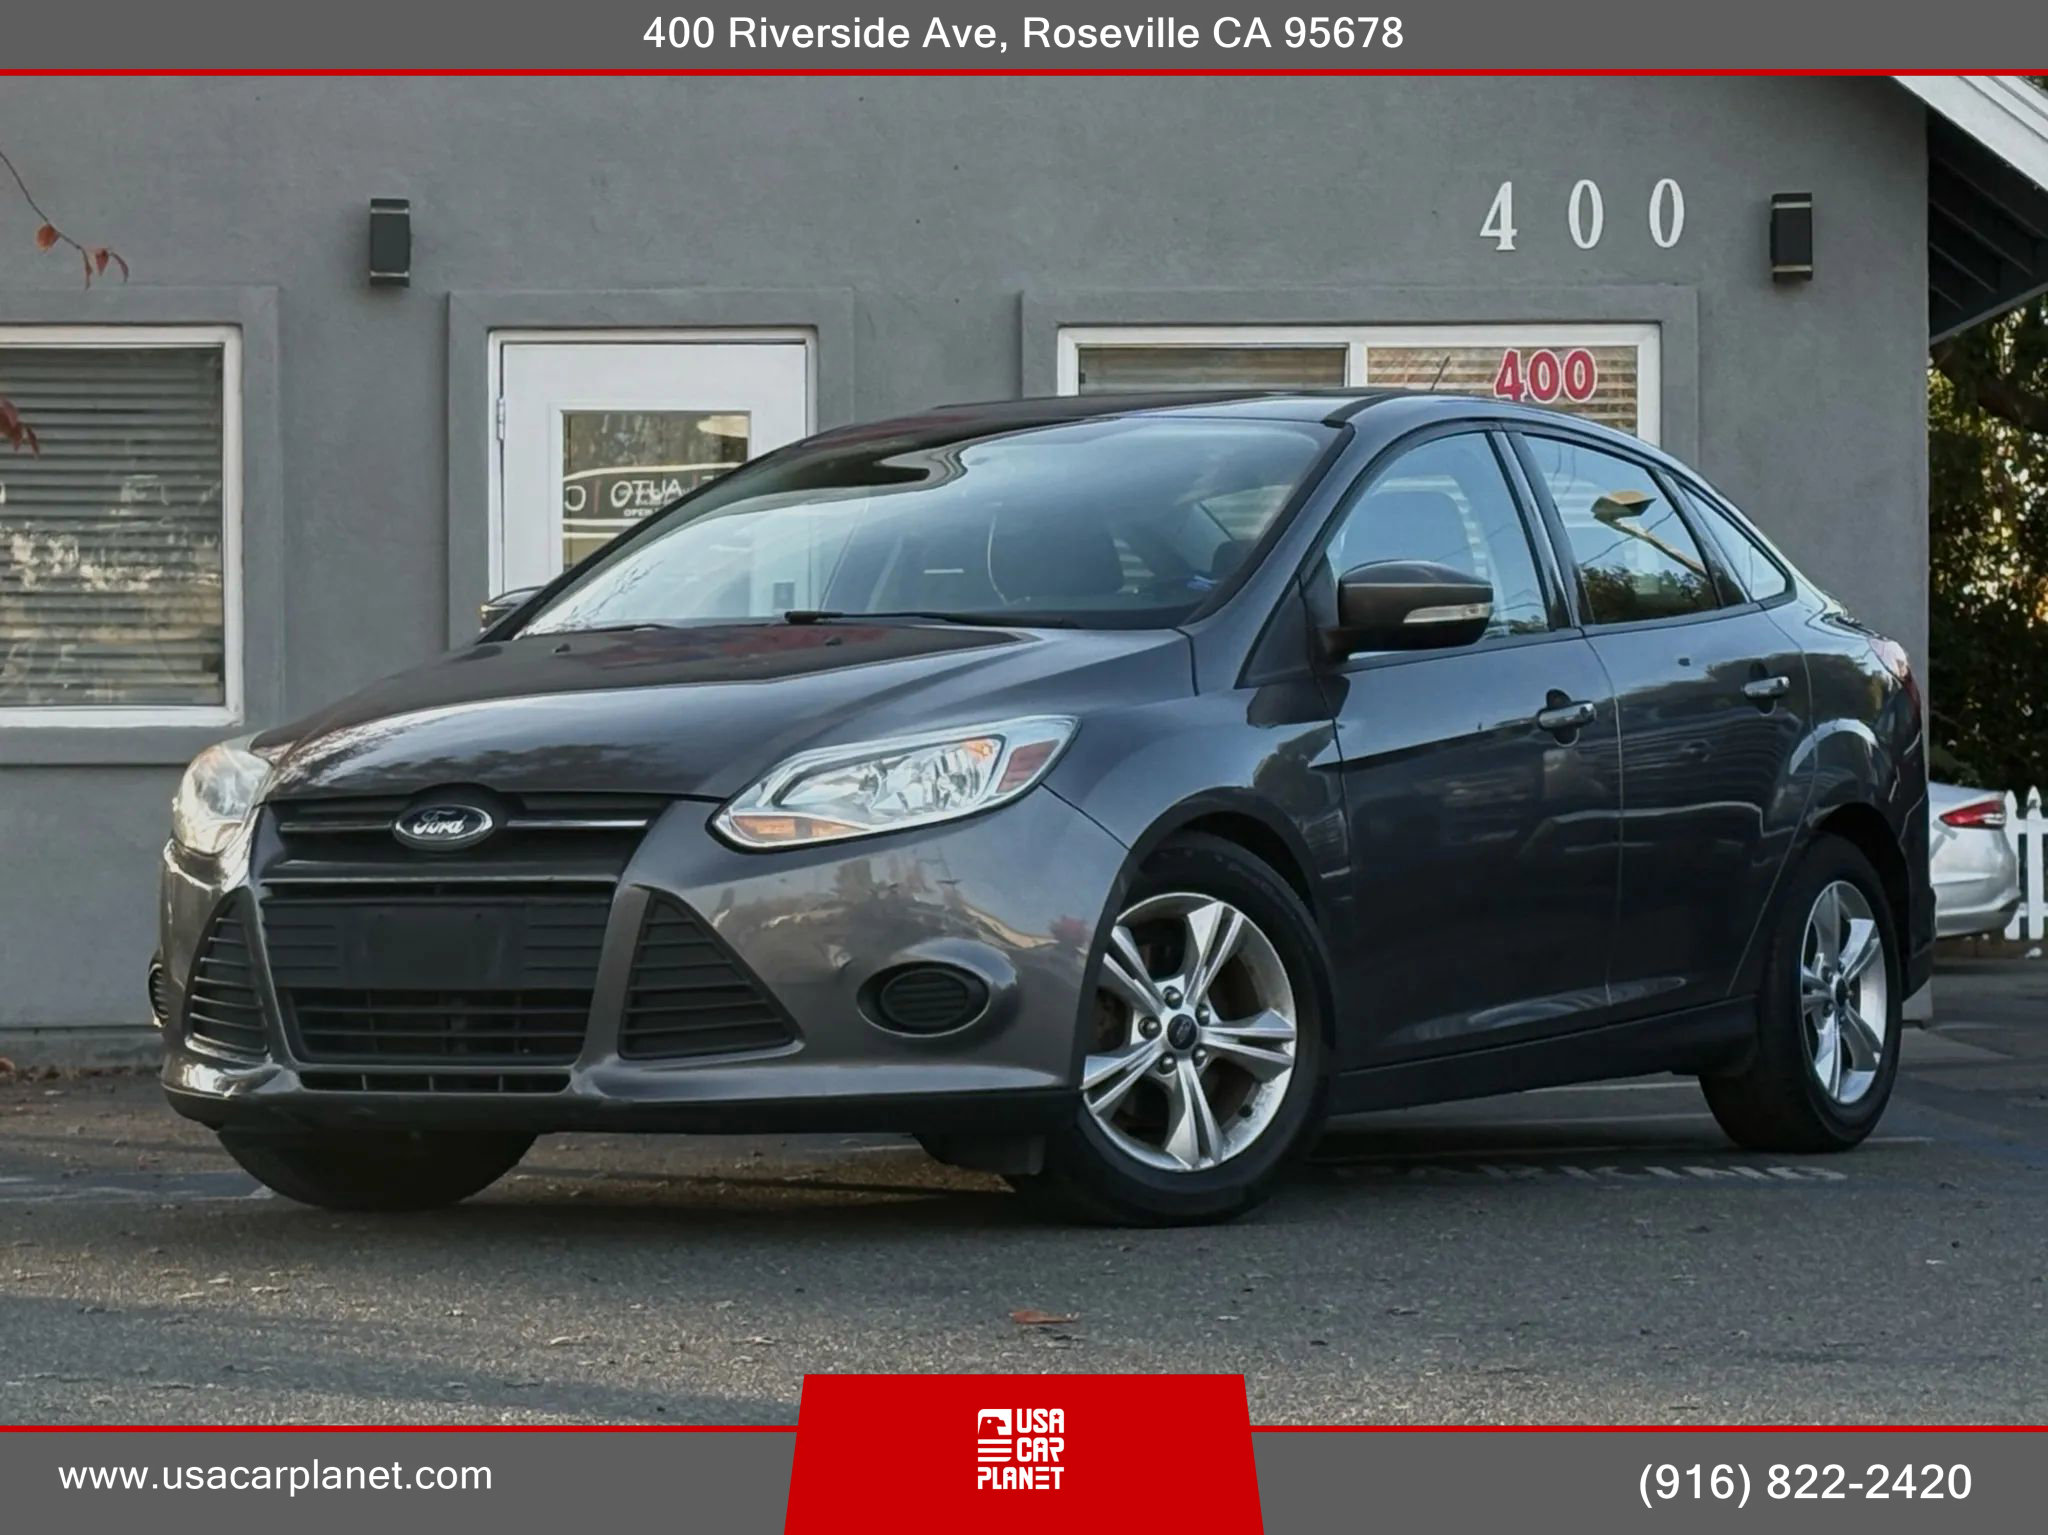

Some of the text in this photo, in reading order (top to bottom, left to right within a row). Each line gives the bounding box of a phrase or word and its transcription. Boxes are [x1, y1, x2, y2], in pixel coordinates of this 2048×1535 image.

[1479, 178, 1685, 250] 400
[1493, 348, 1598, 404] 400
[413, 810, 468, 835] Ford
